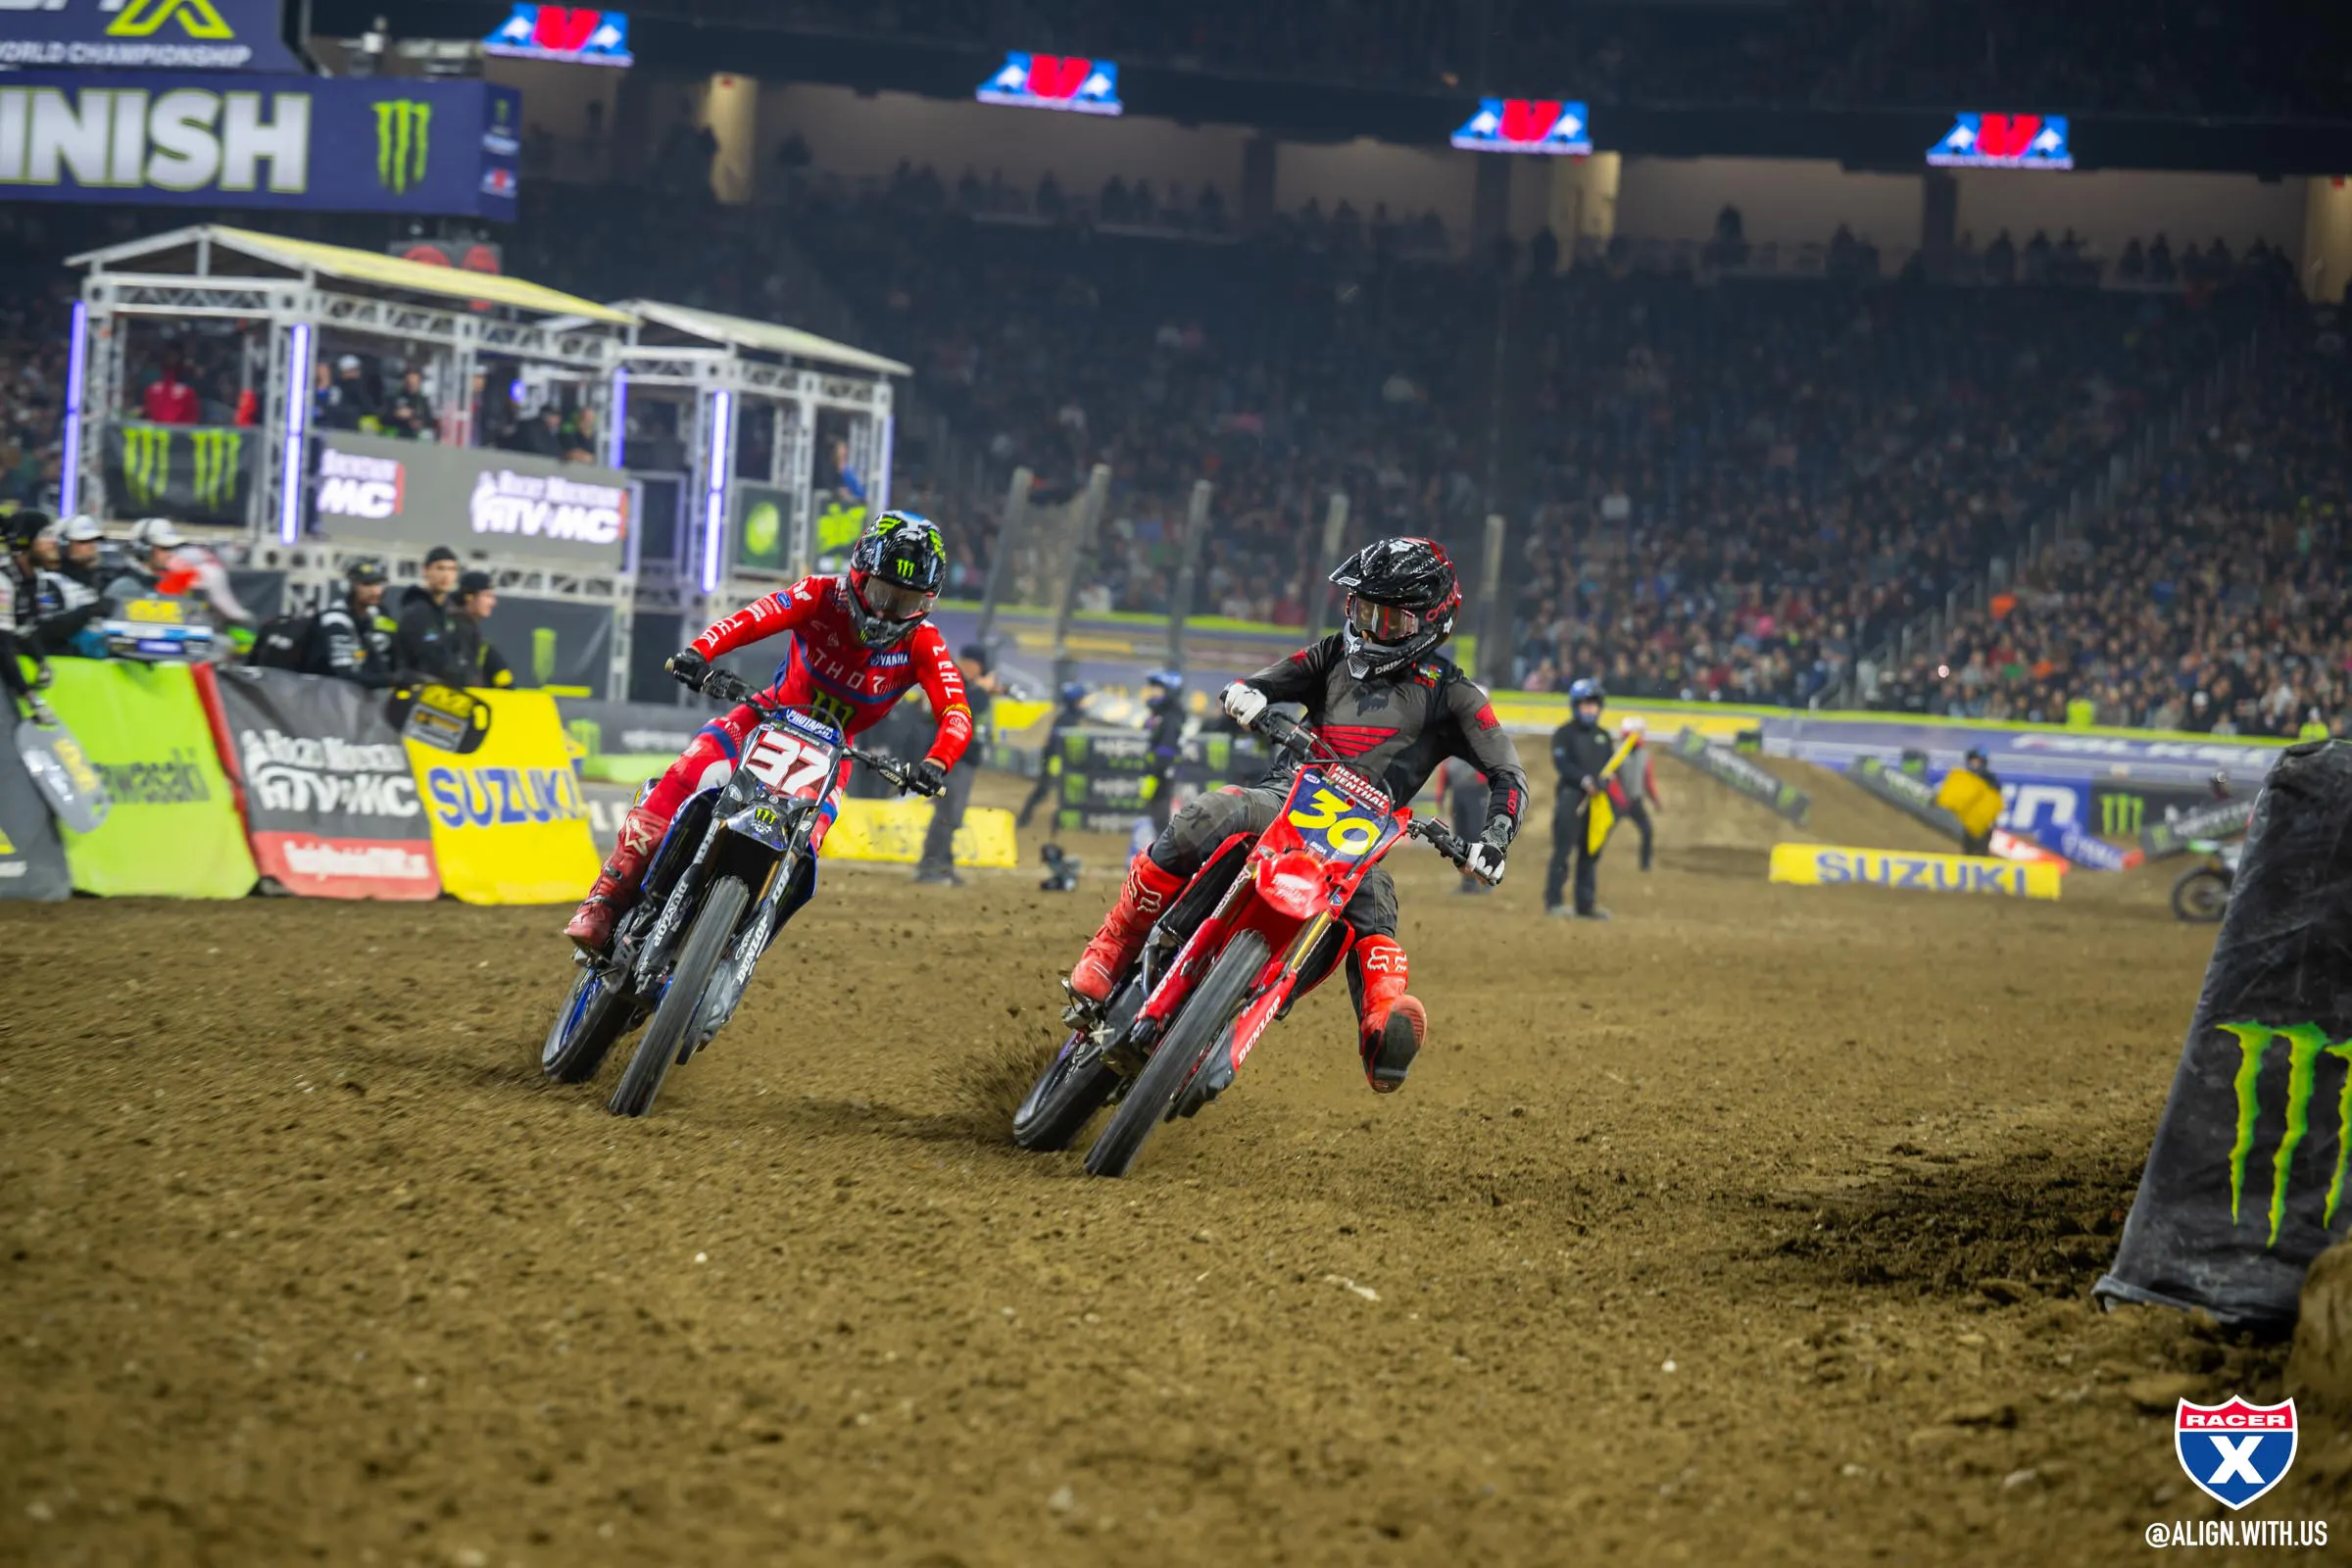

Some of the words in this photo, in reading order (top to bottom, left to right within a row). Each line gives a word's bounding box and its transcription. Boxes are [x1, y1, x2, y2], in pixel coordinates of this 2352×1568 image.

[745, 730, 831, 796] 37
[1331, 772, 1386, 809] RENTHAL
[1288, 788, 1381, 856] 30
[1815, 850, 2027, 898] SUZUKI
[1239, 995, 1281, 1065] DUNLOP
